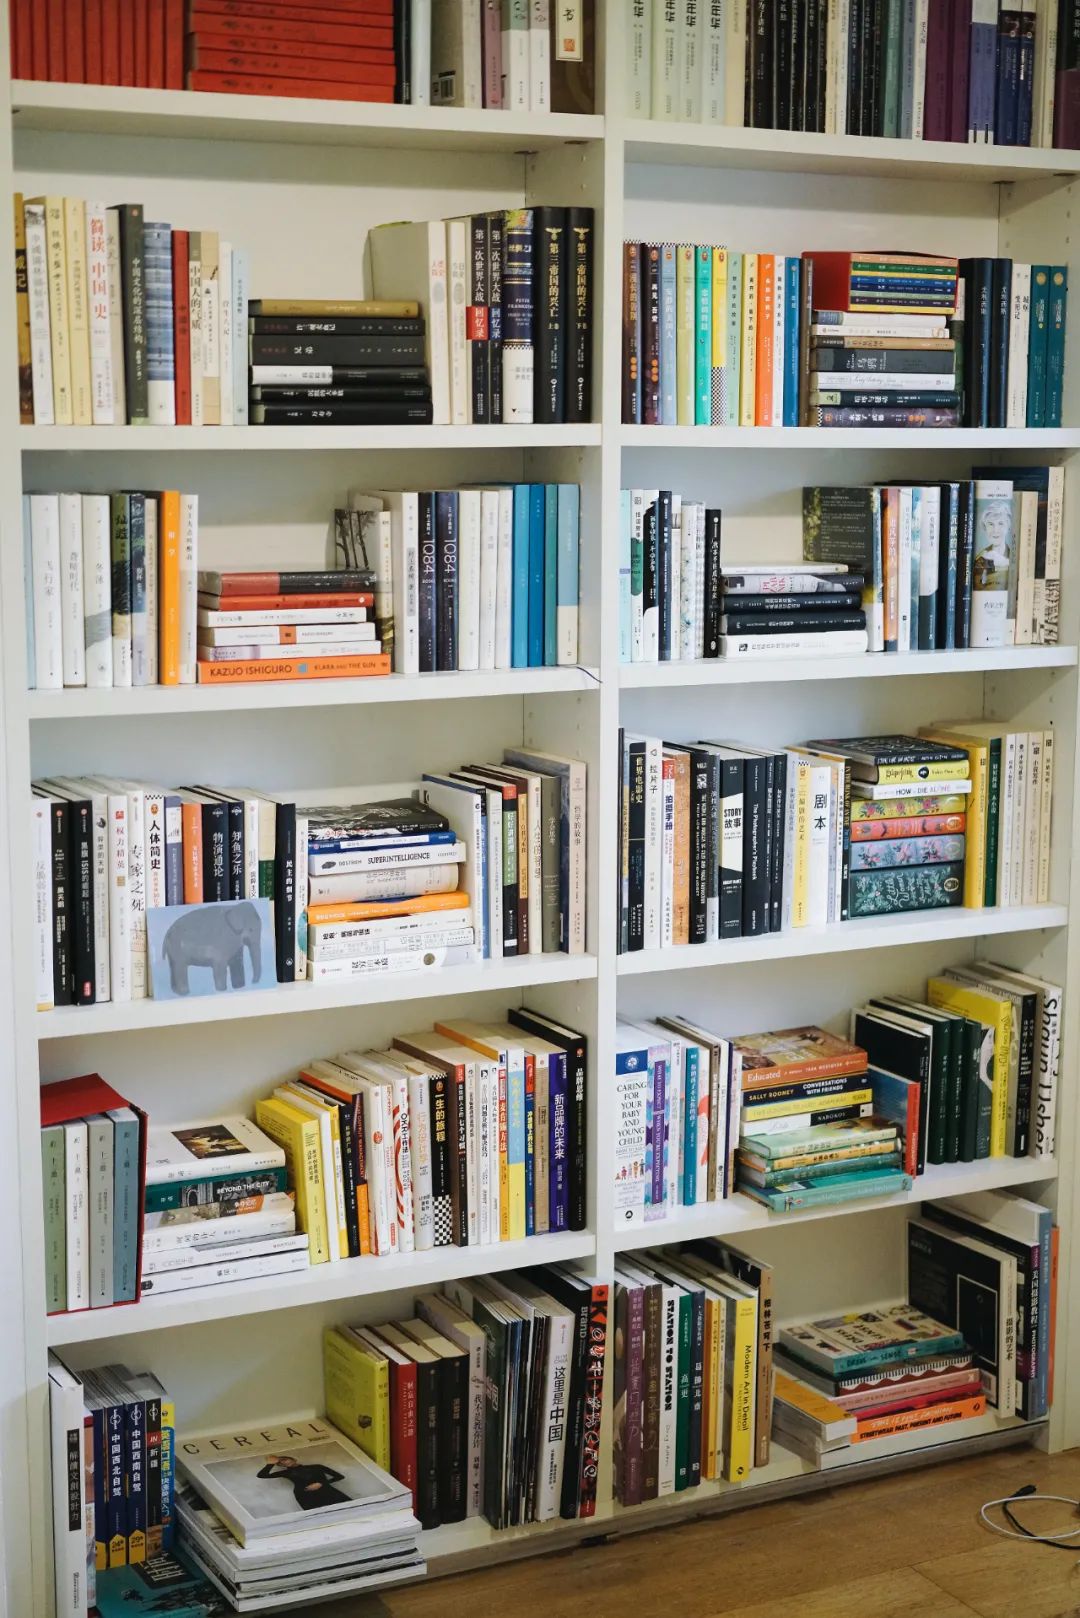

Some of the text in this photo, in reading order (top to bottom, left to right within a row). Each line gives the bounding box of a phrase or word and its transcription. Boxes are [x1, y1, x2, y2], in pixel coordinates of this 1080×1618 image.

[549, 243, 560, 318] 第三帝国的兴亡
[576, 243, 587, 318] 第三帝国的兴亡
[473, 309, 485, 339] 回忆录
[422, 538, 436, 574] 1Q84
[443, 538, 457, 574] 1Q84
[210, 665, 292, 677] KAZUO ISHIGURO
[724, 808, 742, 817] STORY
[814, 794, 827, 830] 剧本
[725, 818, 742, 828] 故事
[149, 820, 161, 870] 人体简史
[231, 831, 242, 876] 知鱼之乐
[367, 852, 430, 865] SUPERINTELLIGENCE
[748, 1071, 781, 1082] Educated
[1035, 998, 1057, 1155] Shaun Usher
[617, 1082, 646, 1092] CARING
[803, 1078, 847, 1090] CONVERSATIONS
[822, 1084, 844, 1093] FRIENDS
[624, 1091, 639, 1099] FOR
[749, 1089, 794, 1101] SALLY ROONEY
[621, 1100, 642, 1109] YOUR
[436, 1093, 445, 1142] 一生的旅程
[622, 1110, 640, 1118] BABY
[555, 1094, 564, 1159] 新品牌的未来
[623, 1118, 639, 1127] AND
[618, 1127, 644, 1137] YOUNG
[618, 1136, 643, 1147] CHILD
[216, 1184, 243, 1194] BEYOND
[255, 1180, 270, 1188] CITY
[664, 1300, 675, 1411] STATION TO STATION
[548, 1366, 566, 1443] 这里是中国
[150, 1435, 158, 1443] IN
[183, 1423, 325, 1454] CEREAL
[111, 1434, 121, 1496] 中国西北自驾
[132, 1430, 141, 1492] 中国西南自驾
